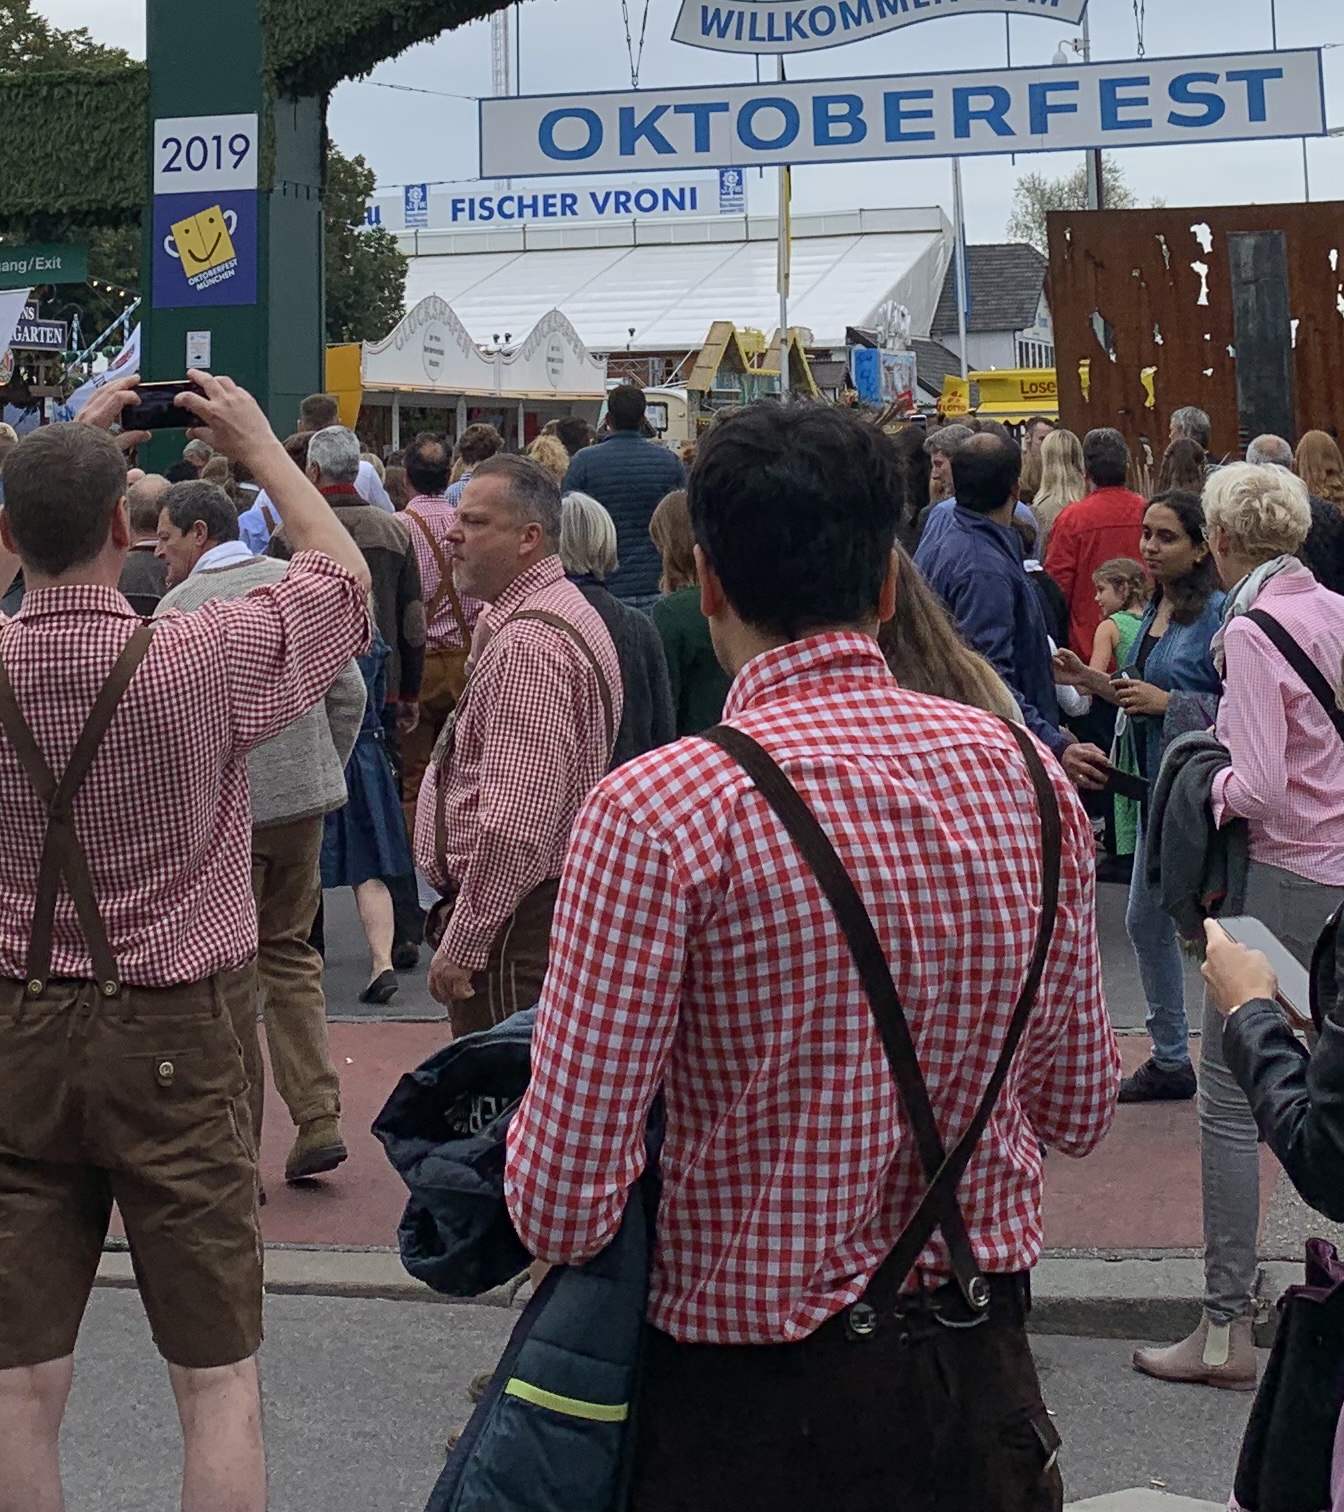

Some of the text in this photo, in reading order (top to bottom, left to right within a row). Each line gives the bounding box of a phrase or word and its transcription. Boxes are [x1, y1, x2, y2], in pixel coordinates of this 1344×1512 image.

[537, 67, 1284, 161] OKTOBERFEST
[161, 133, 251, 173] 2019
[451, 192, 579, 223] FISCHER
[589, 186, 698, 216] VRONI
[188, 258, 238, 286] OKTOBERFEST
[196, 268, 236, 291] MÜNCHEN
[11, 325, 64, 345] GARTEN
[1020, 379, 1057, 395] Lose
[942, 404, 967, 412] LOTTO
